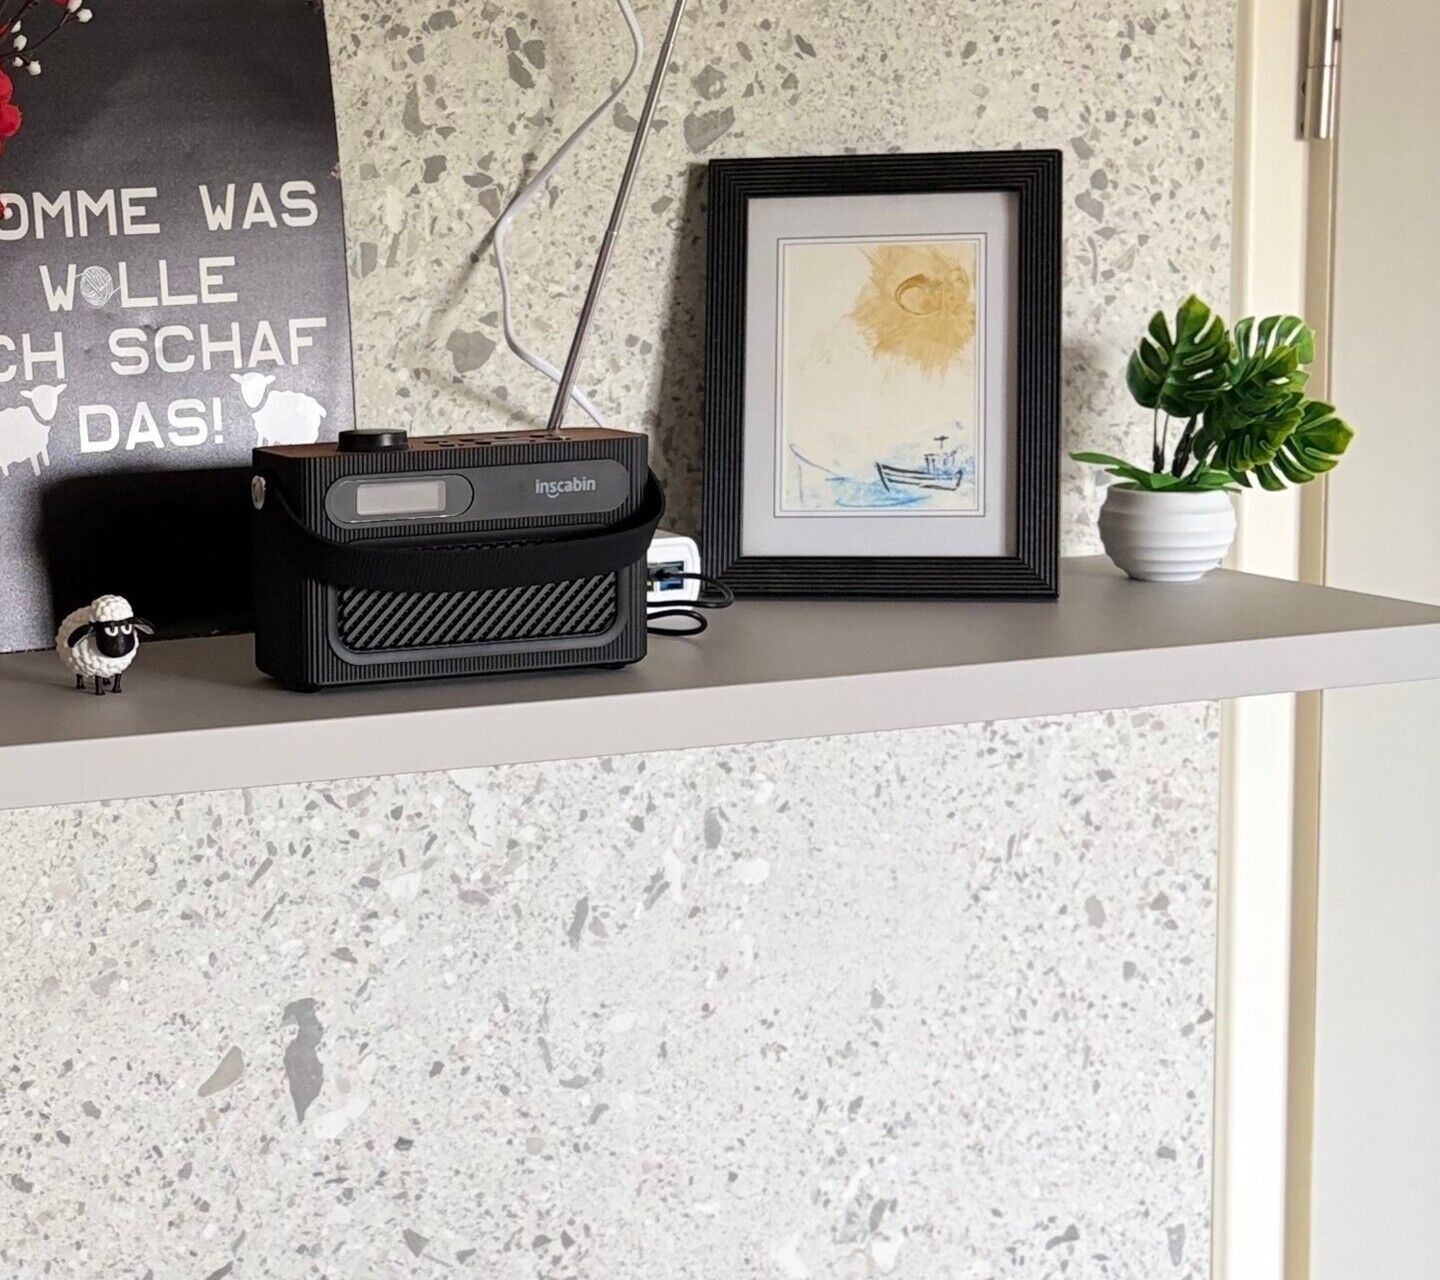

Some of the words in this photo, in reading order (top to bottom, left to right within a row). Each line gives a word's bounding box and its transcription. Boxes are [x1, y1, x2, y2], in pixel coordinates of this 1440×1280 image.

[197, 181, 319, 231] WAS
[39, 256, 239, 312] WOLLE
[108, 317, 327, 376] SCHAF
[78, 397, 224, 453] DAS!
[535, 476, 596, 498] inscabin
